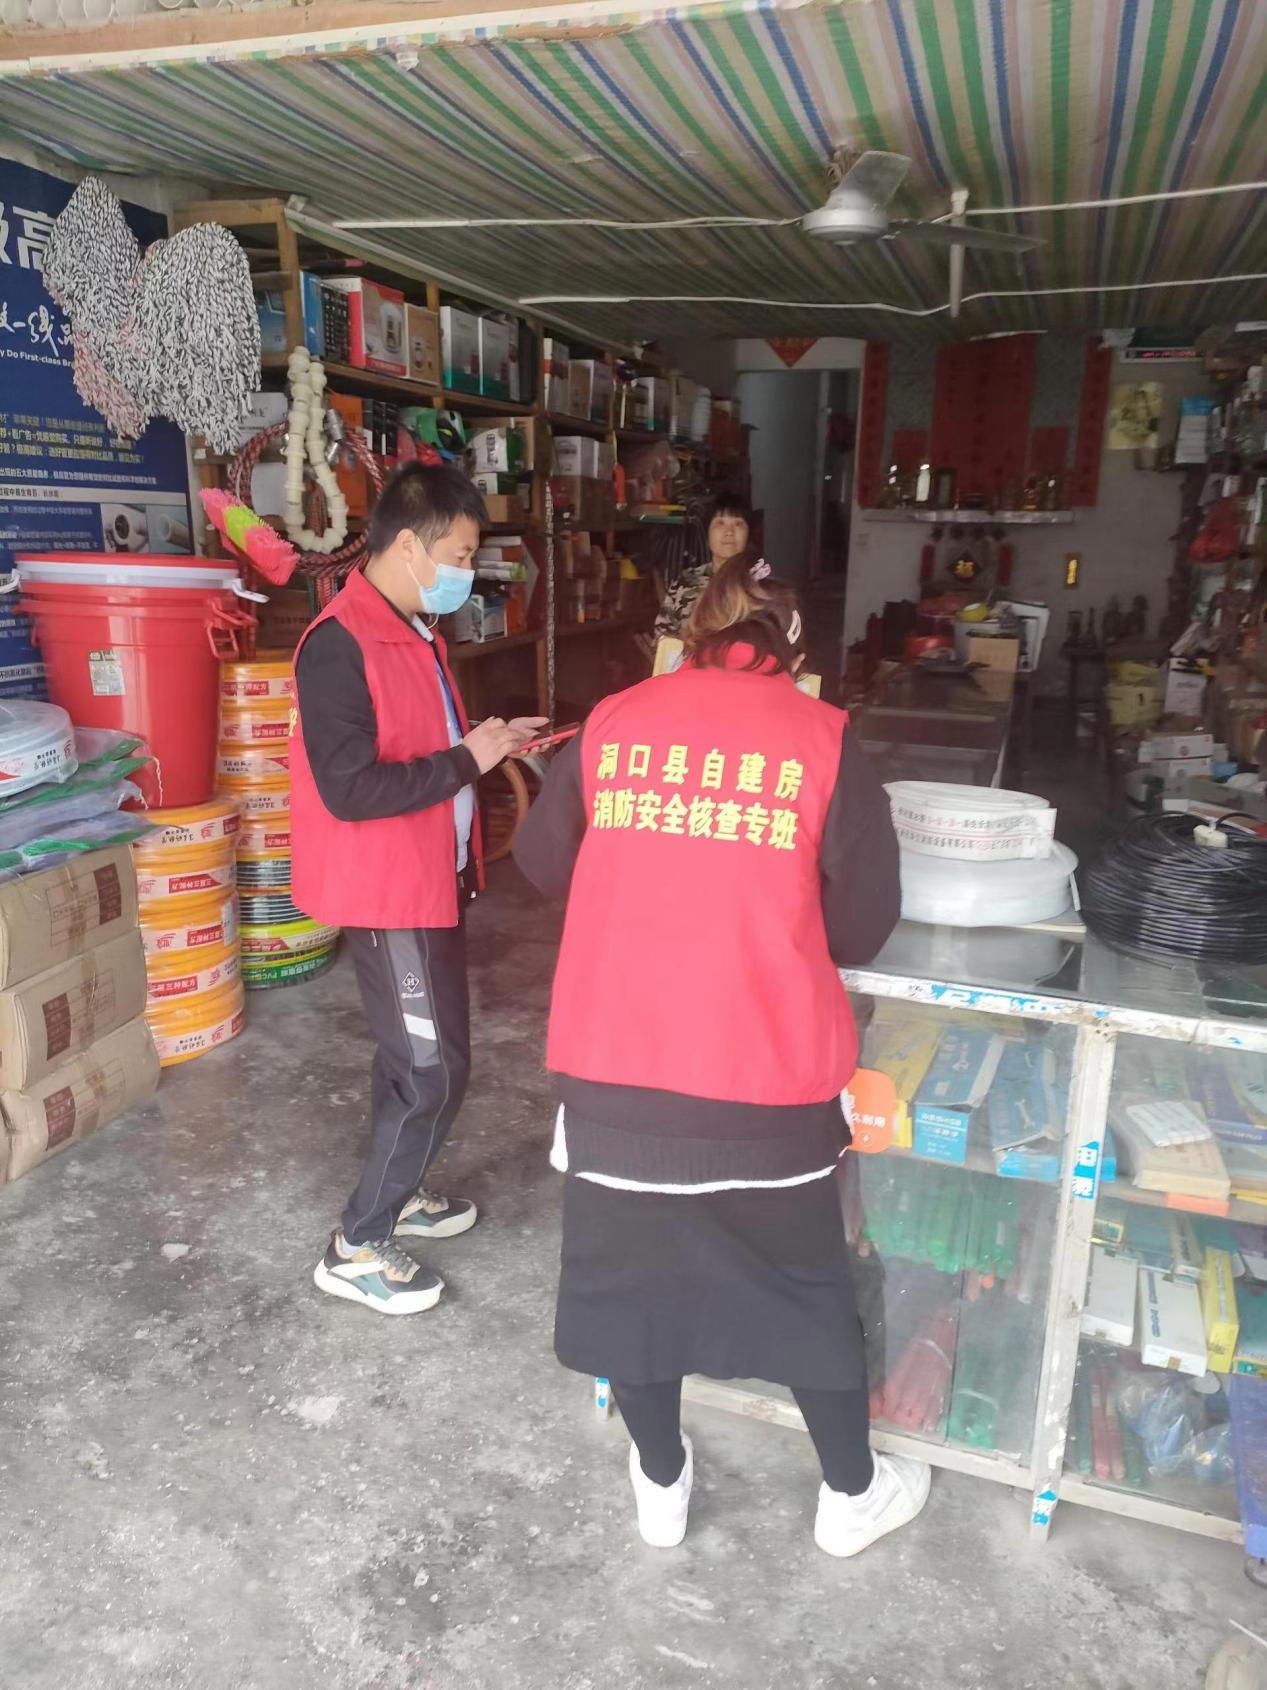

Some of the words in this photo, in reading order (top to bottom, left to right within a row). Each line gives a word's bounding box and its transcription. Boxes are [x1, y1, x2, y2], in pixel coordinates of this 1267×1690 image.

[0, 203, 58, 270] 高
[6, 349, 19, 358] Do
[20, 351, 61, 366] First-class
[597, 742, 804, 802] 洞口县自建房
[593, 787, 799, 851] 消防安全核查专班
